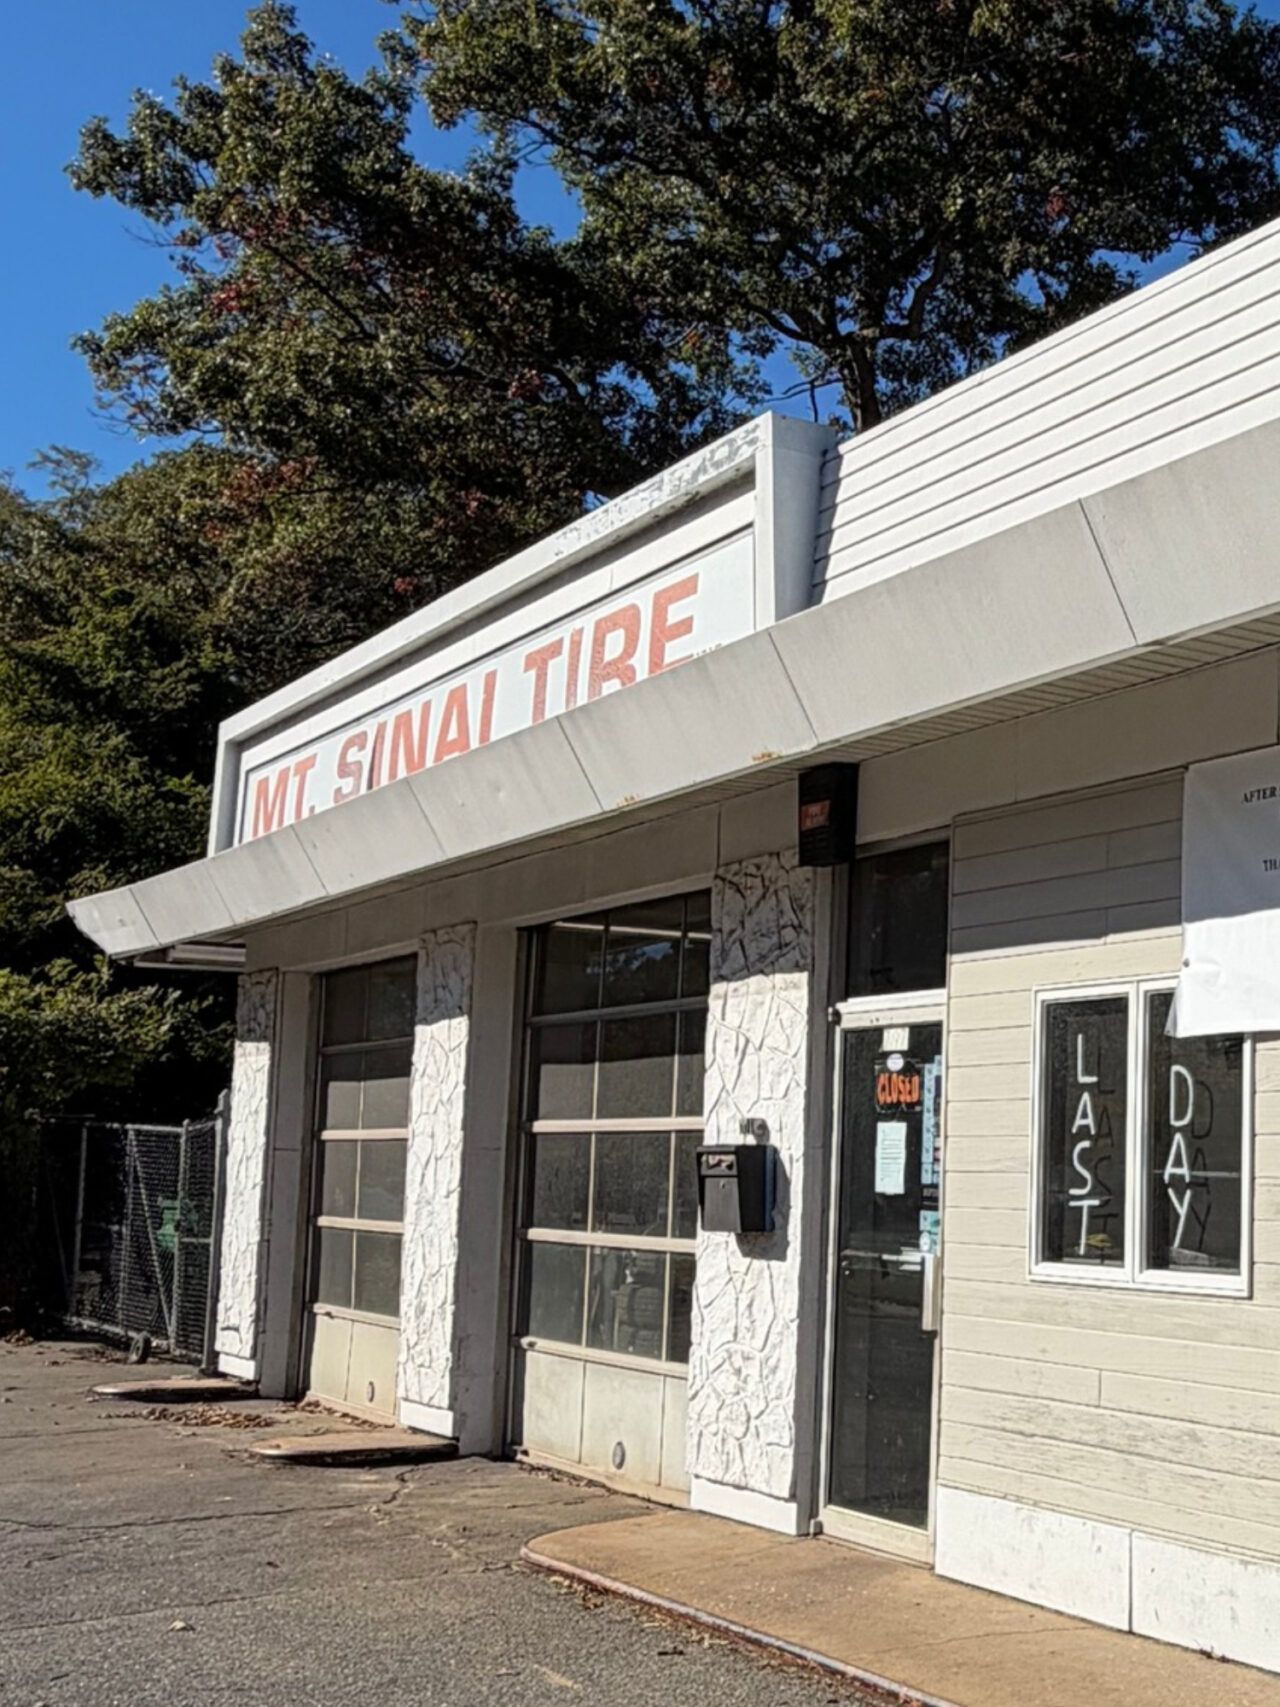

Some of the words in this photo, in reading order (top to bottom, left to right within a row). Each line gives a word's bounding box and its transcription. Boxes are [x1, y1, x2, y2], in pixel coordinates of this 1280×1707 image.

[252, 753, 317, 838] MT.
[333, 669, 497, 804] SINAI
[523, 572, 699, 726] TIRE
[1241, 785, 1277, 803] AFTER
[877, 1073, 920, 1104] CLOSED
[1069, 1033, 1099, 1255] LAST
[1164, 1064, 1194, 1248] DAY
